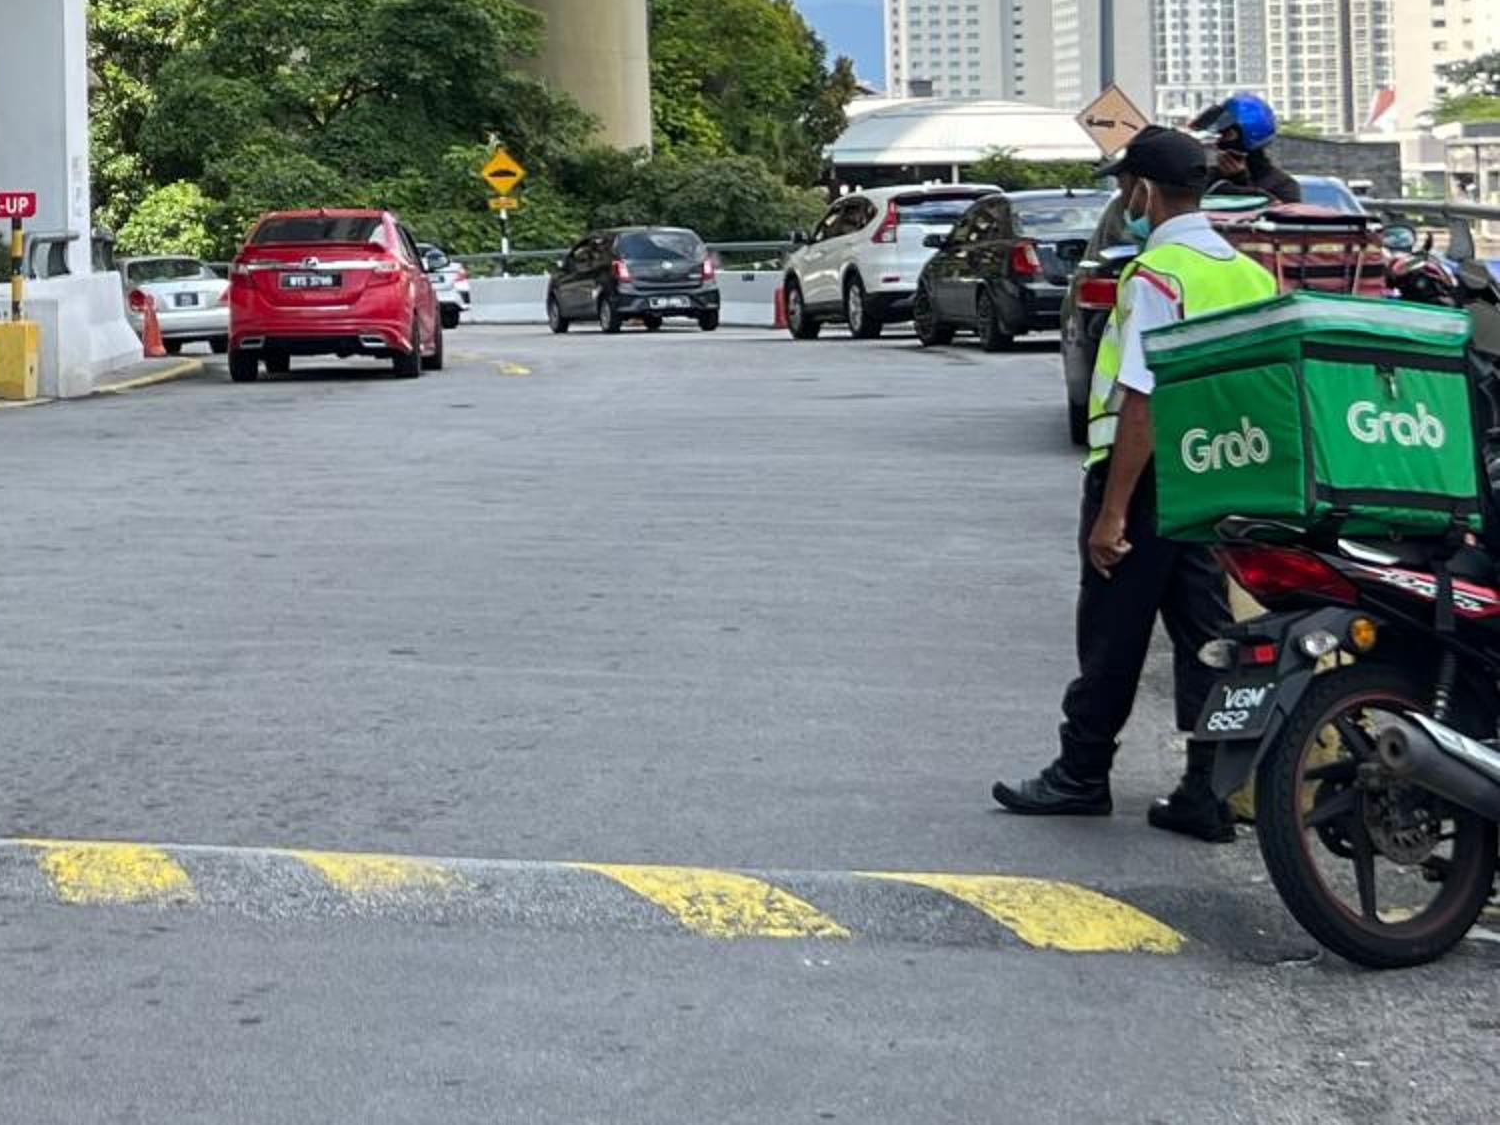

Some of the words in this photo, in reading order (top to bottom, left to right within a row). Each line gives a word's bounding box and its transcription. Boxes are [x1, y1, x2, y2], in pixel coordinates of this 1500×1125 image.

[1181, 416, 1270, 473] Grab
[1347, 400, 1445, 449] Grab
[1207, 710, 1249, 731] 852
